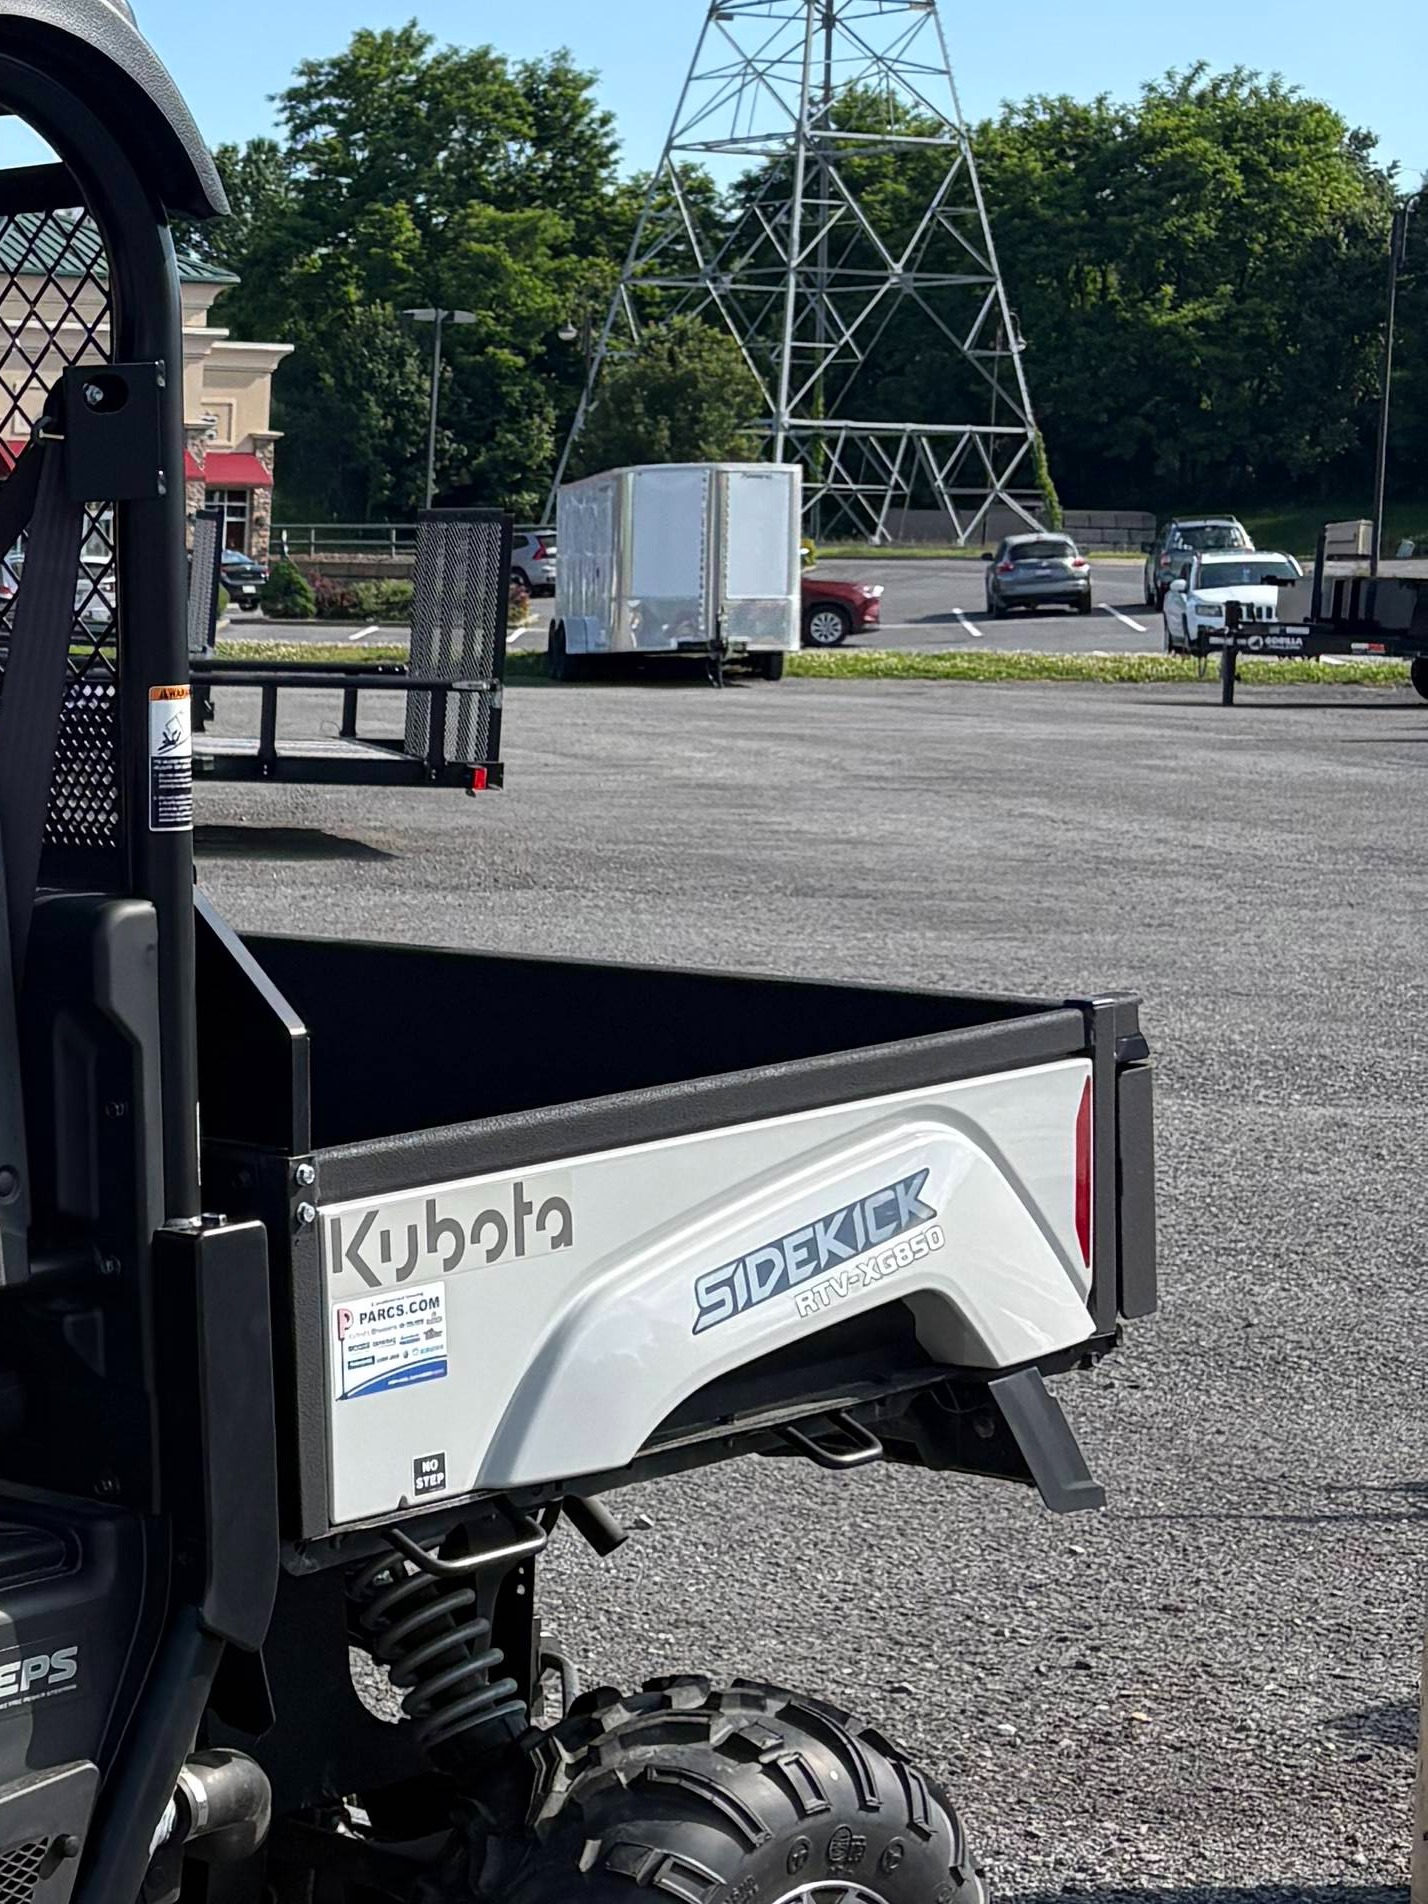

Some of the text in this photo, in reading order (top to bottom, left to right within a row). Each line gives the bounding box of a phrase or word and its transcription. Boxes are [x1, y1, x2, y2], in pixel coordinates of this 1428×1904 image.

[330, 1181, 573, 1288] Kubota
[693, 1171, 935, 1334] SIDEKICK
[794, 1224, 946, 1319] RTV-XG850
[359, 1296, 440, 1325] PARCS.COM
[416, 1472, 445, 1489] STEP
[422, 1459, 439, 1472] NO
